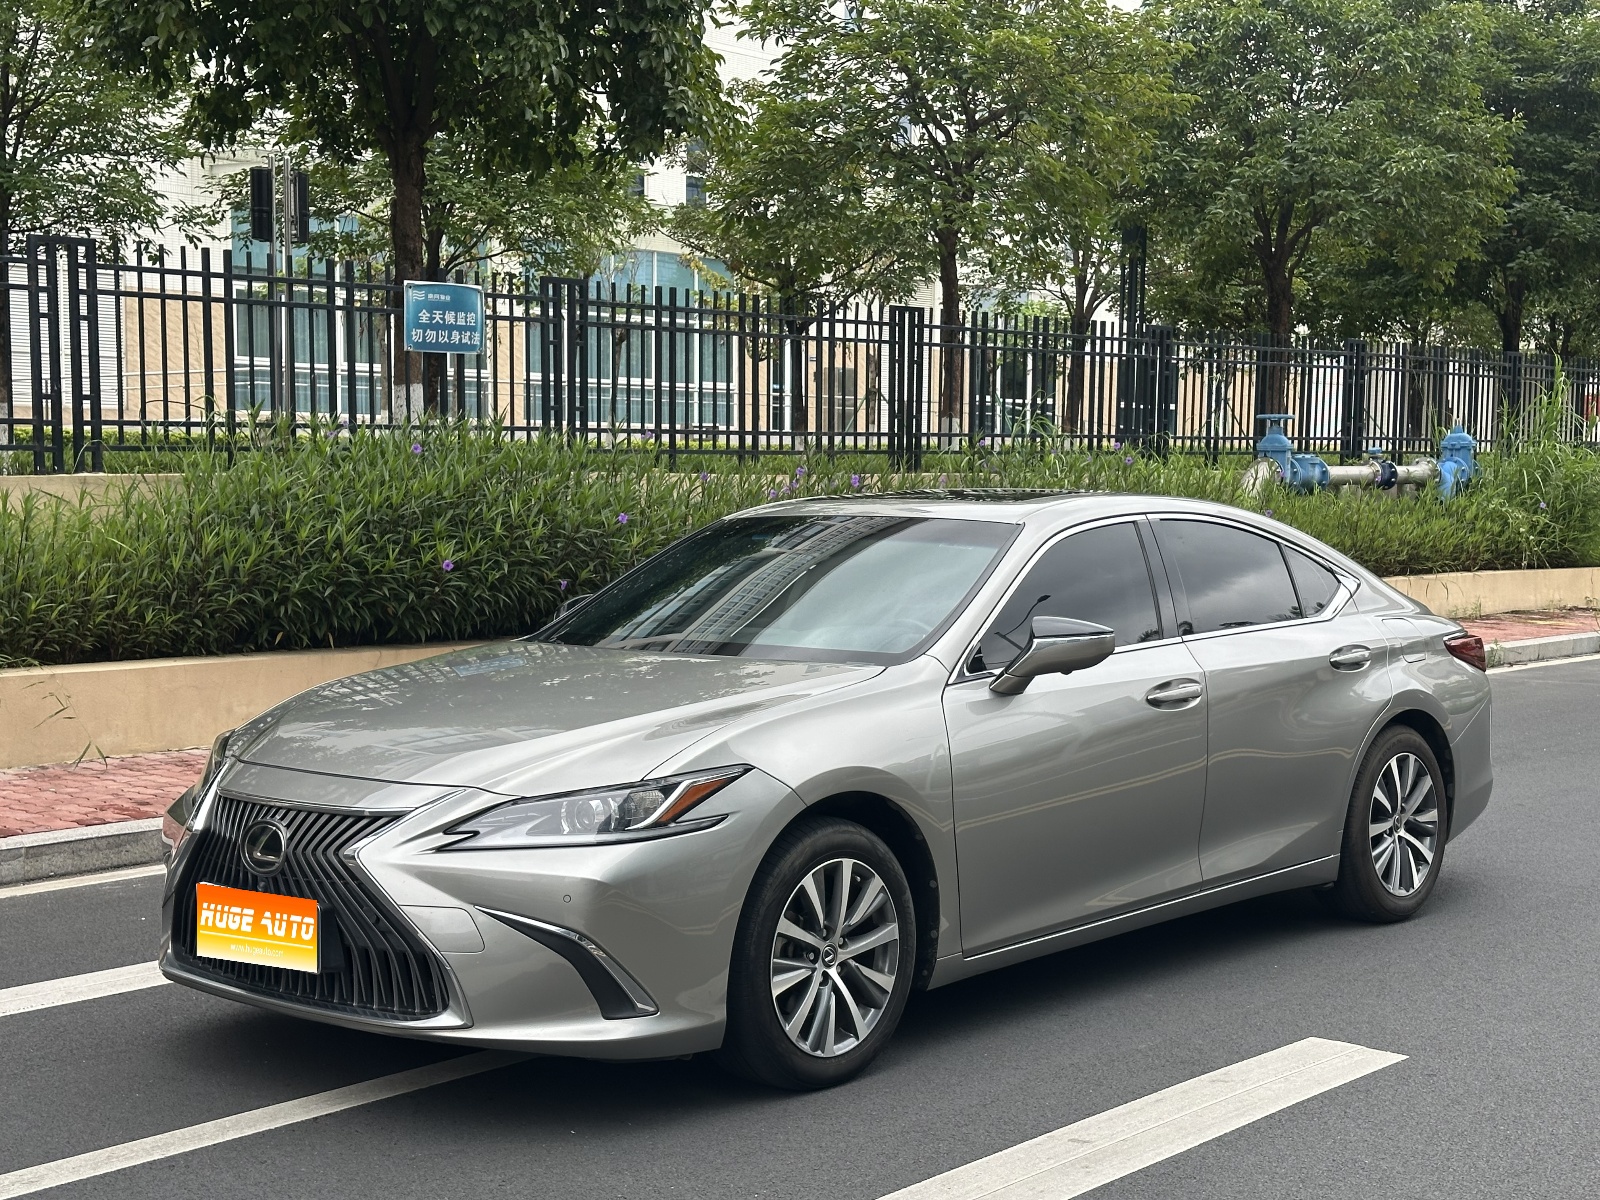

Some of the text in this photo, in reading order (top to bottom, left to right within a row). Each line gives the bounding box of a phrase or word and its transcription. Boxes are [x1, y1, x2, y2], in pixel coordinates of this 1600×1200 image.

[418, 309, 476, 326] 全天候监控
[411, 328, 480, 345] 切勿以身试法
